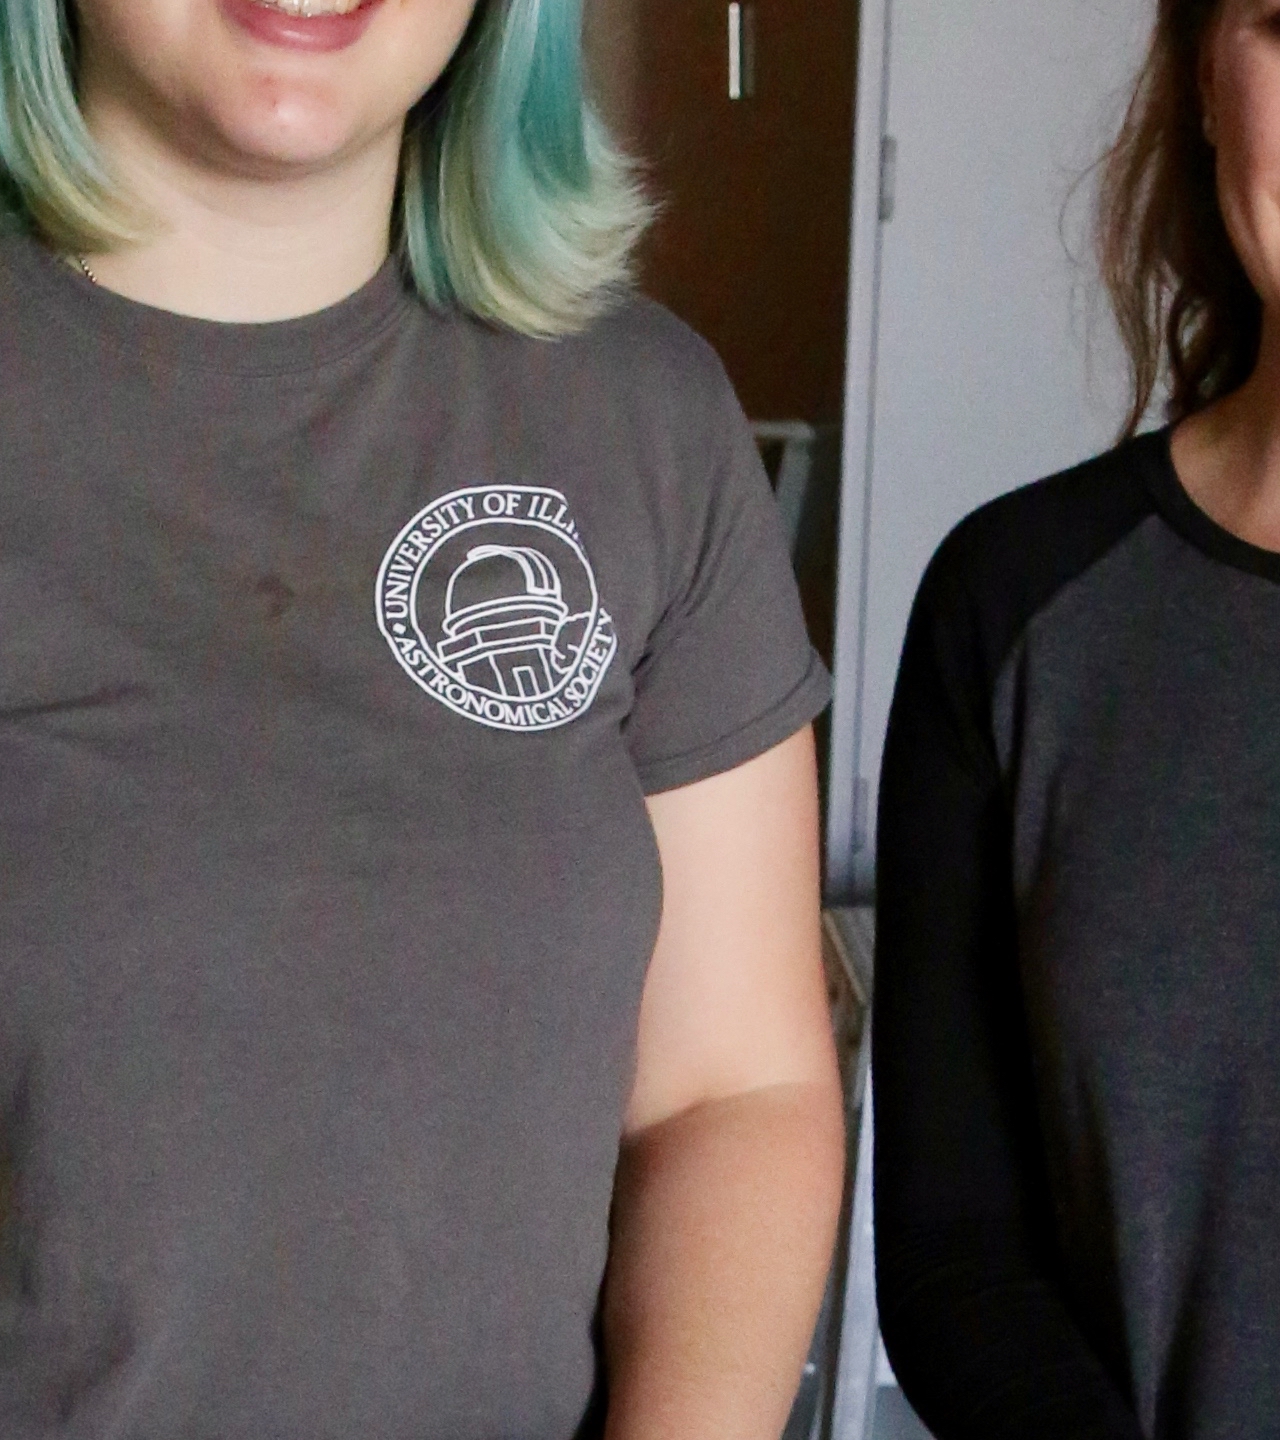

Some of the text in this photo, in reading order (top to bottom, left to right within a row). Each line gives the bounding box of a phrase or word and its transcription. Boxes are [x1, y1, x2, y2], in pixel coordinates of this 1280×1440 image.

[385, 495, 476, 620] UNIVERSITY
[483, 492, 523, 517] OF
[394, 607, 613, 726] ASTRONOMICAL SOCIETY
